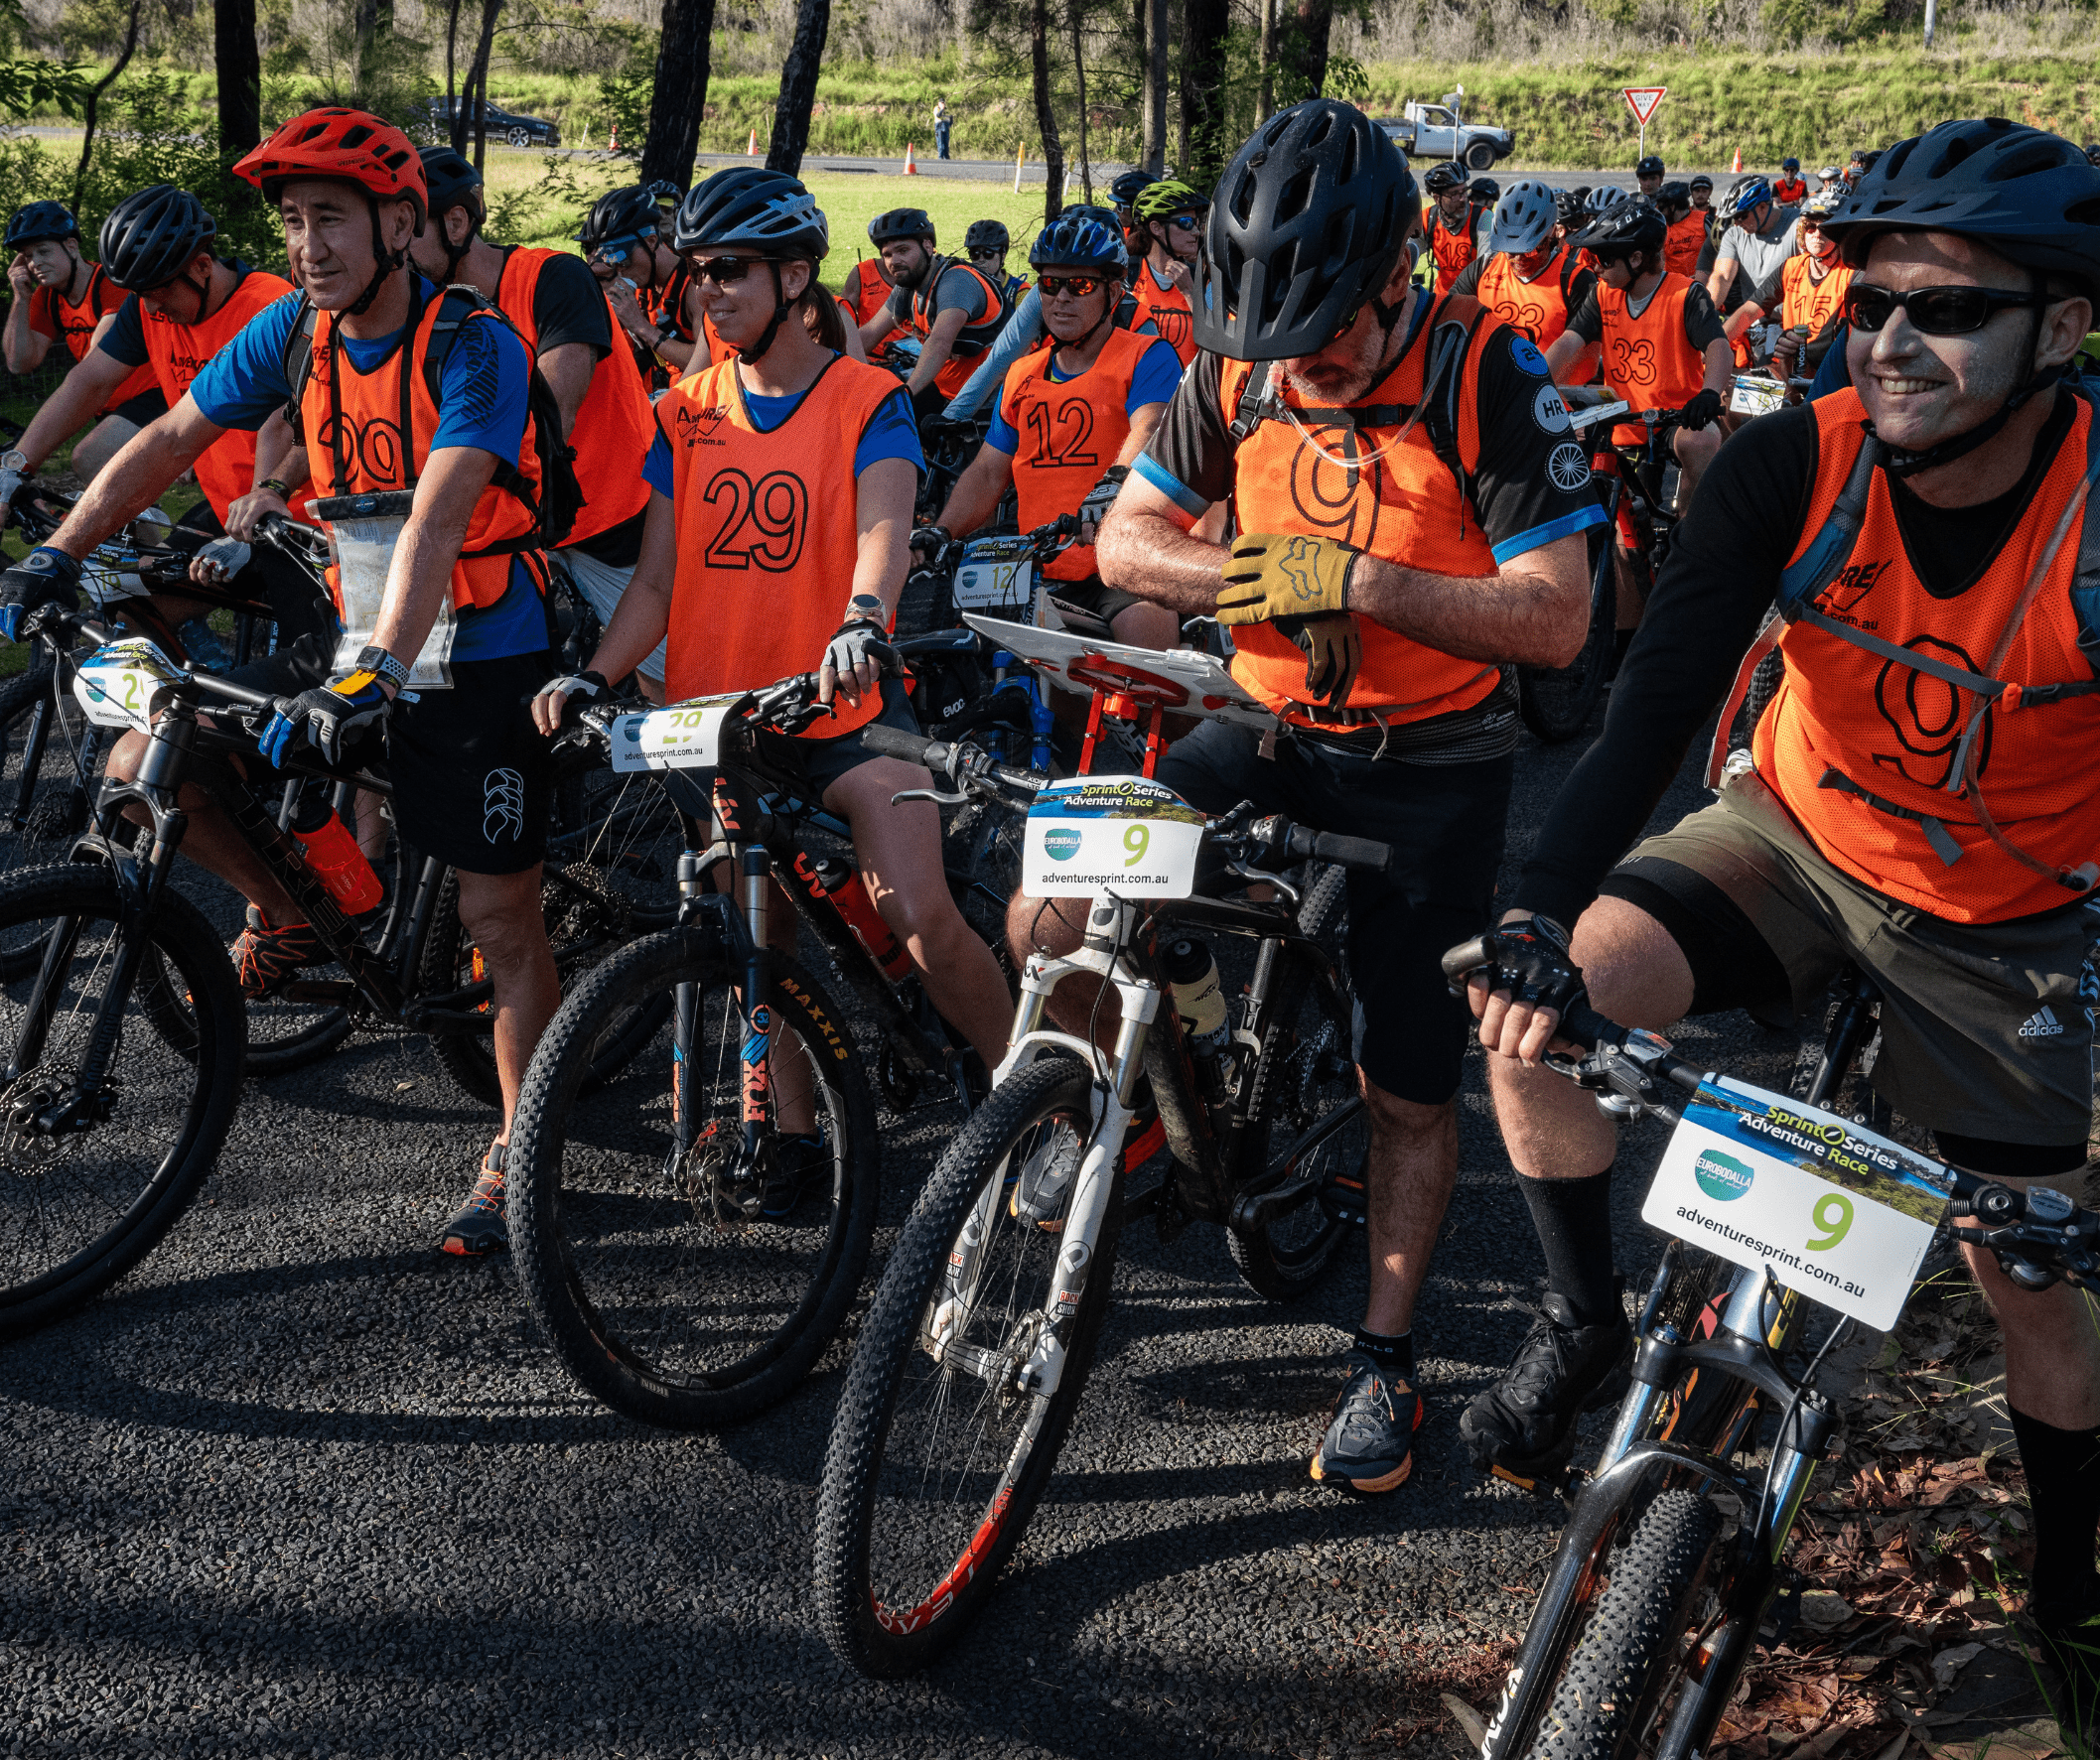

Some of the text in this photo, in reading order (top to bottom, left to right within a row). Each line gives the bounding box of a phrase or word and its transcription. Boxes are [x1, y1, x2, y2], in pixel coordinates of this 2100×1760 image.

[1614, 209, 1643, 230] FOX
[1443, 242, 1471, 272] 18
[1795, 296, 1832, 333] 15
[1610, 338, 1656, 385] 33
[1542, 399, 1564, 418] HR
[1757, 394, 1770, 408] 15
[1027, 397, 1098, 469] 12
[1291, 424, 1381, 555] 9
[703, 468, 809, 573] 29
[993, 565, 1013, 589] 12
[122, 673, 146, 710] 2
[943, 698, 965, 718] evoc
[1872, 634, 1993, 800] 9
[624, 747, 703, 761] adventuresprint.com.au
[1063, 796, 1154, 807] Adventure Race
[1081, 785, 1173, 800] Sprint Series
[1123, 824, 1150, 868] 9
[1042, 873, 1169, 885] adventuresprint.com.au
[757, 1013, 770, 1024] 32
[779, 978, 847, 1060] MAXXIS
[2019, 1024, 2063, 1036] adidas
[743, 1059, 768, 1123] FOX
[1739, 1112, 1870, 1176] Adventure Race
[1766, 1106, 1898, 1171] Sprint Series
[1697, 1156, 1752, 1188] EUROBODALLA
[1804, 1192, 1854, 1252] 9
[1676, 1205, 1866, 1298] adventuresprint.com.au
[1056, 1303, 1076, 1316] SHOX
[1059, 1291, 1079, 1302] ROCK
